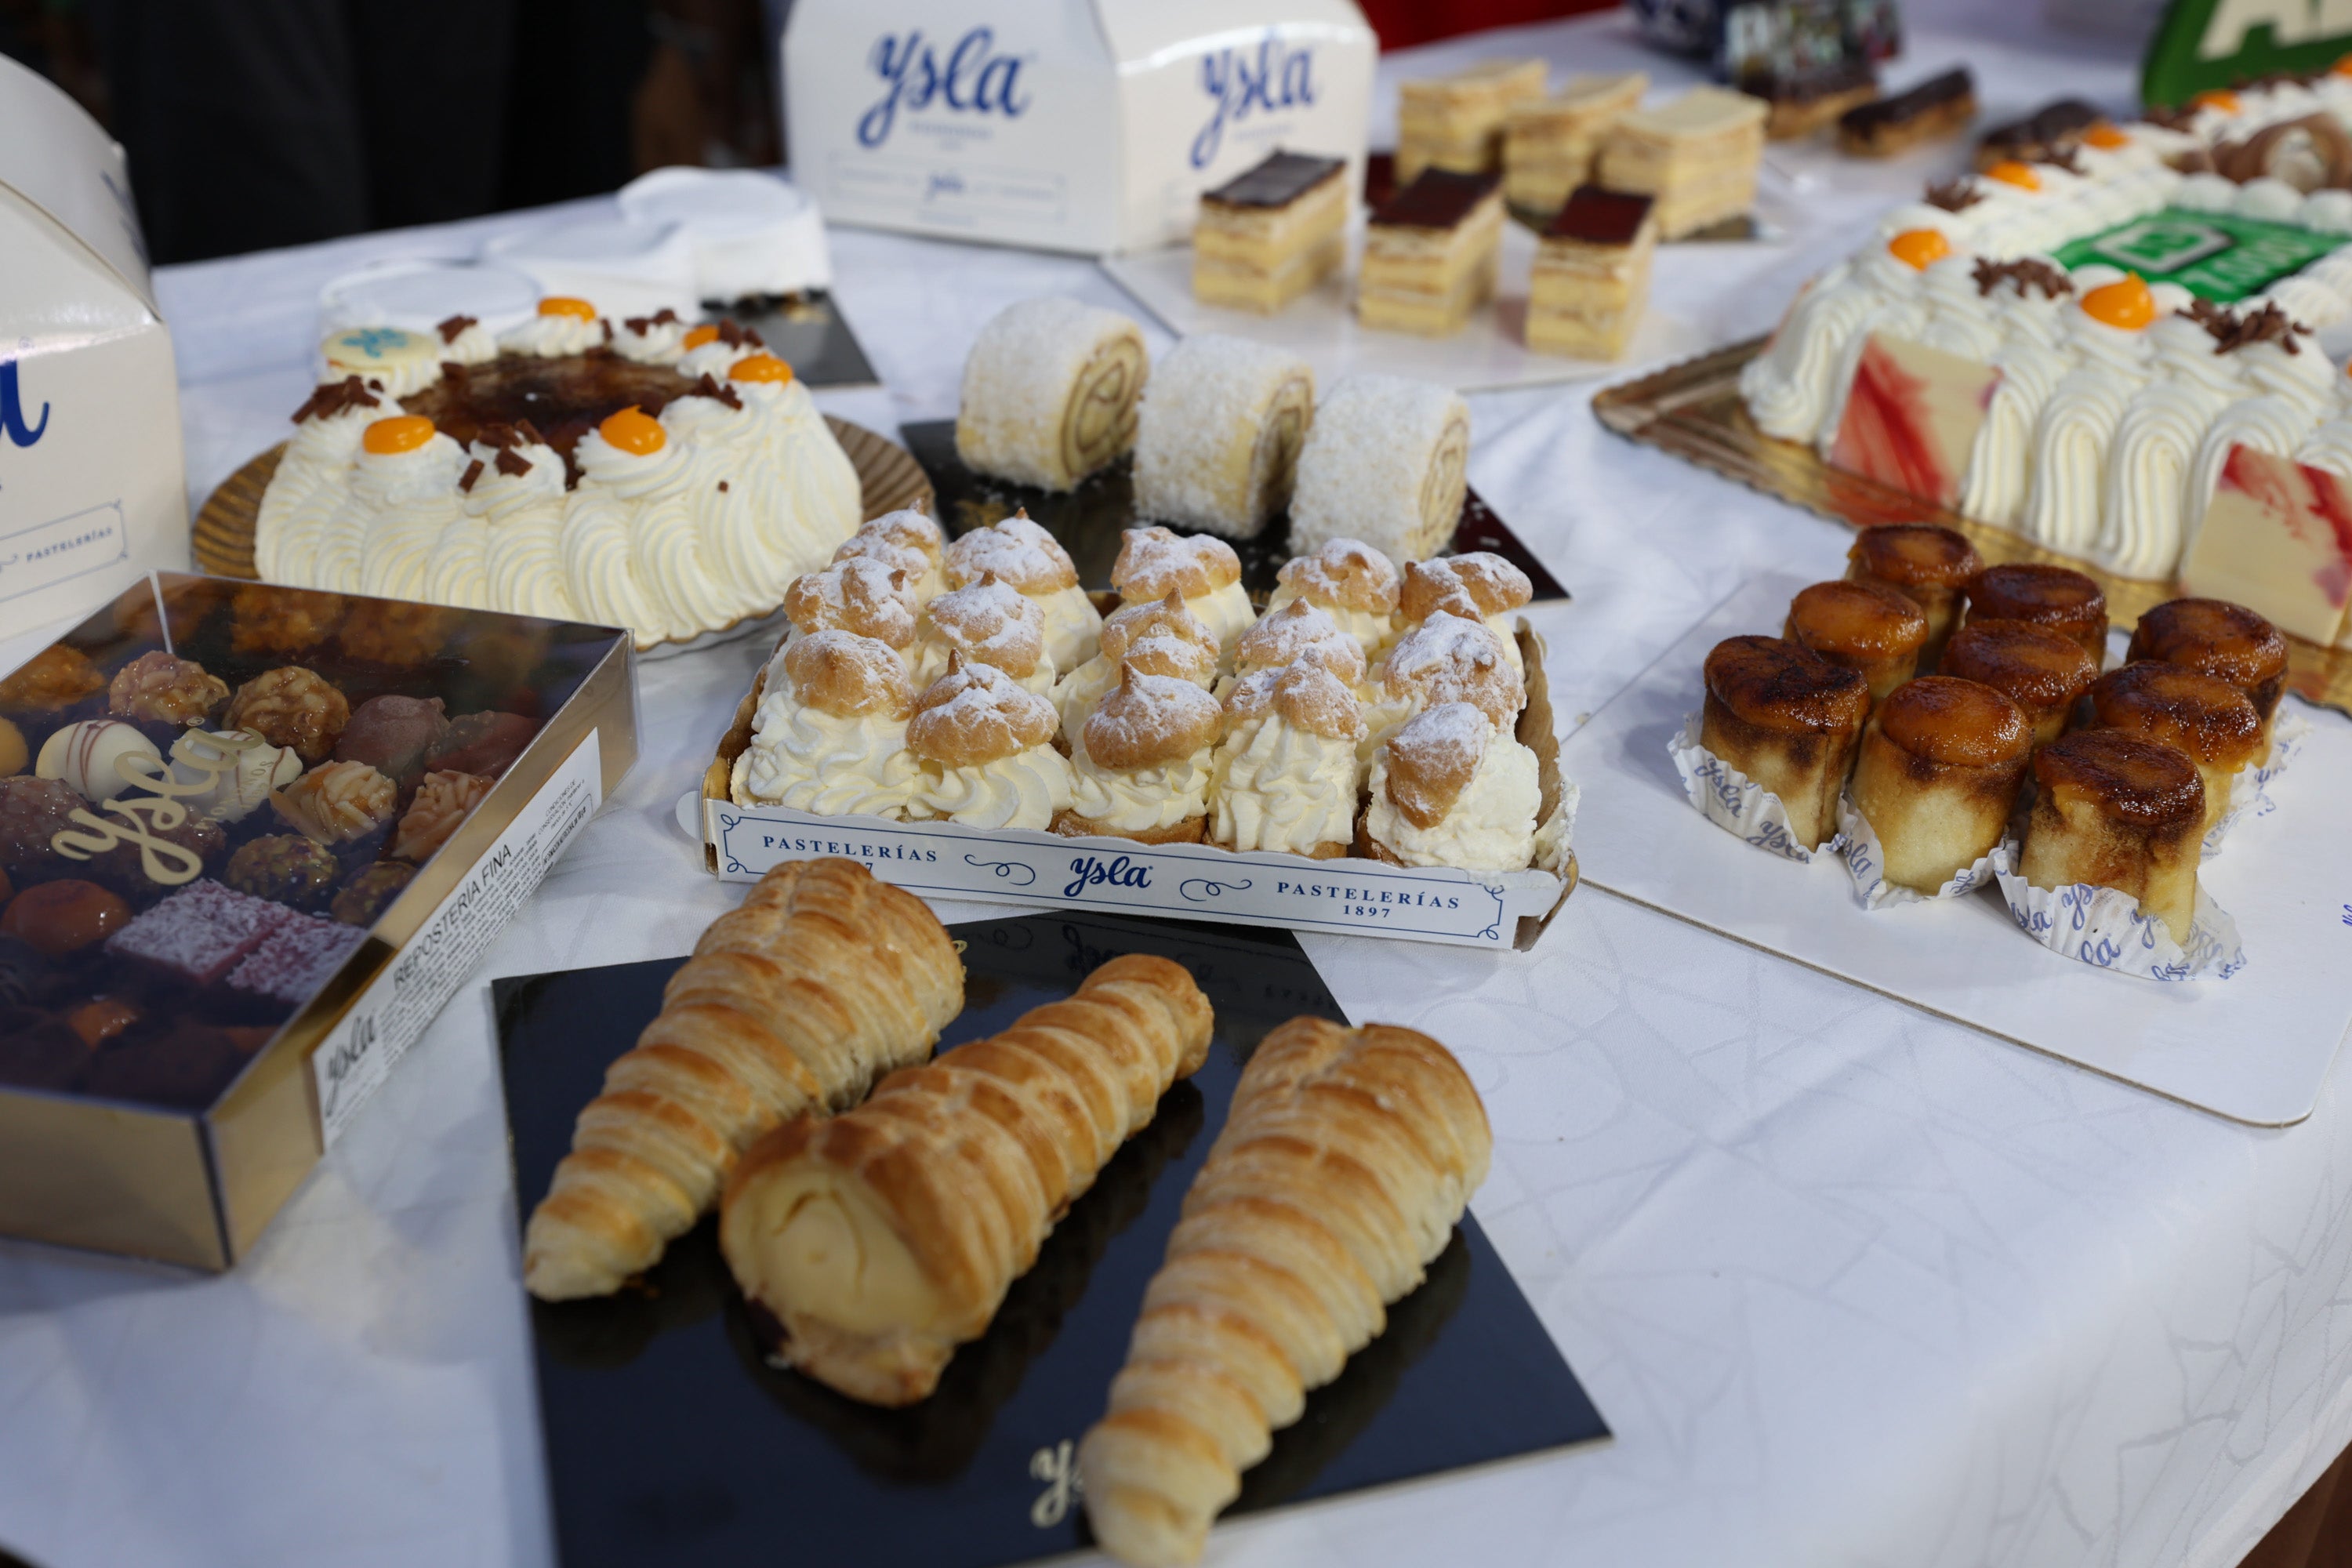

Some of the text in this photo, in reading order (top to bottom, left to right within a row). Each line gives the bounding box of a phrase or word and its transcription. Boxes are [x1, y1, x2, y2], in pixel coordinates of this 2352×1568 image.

[858, 25, 1032, 149] ysla
[1191, 28, 1320, 169] ysla
[27, 526, 113, 563] PASTELERÍAS
[51, 726, 266, 886] ysla
[763, 835, 938, 862] PASTELERÍAS
[1063, 855, 1154, 898] ysla
[1277, 881, 1461, 909] PASTELERÍAS
[393, 880, 481, 992] REPOSTERÍA
[481, 844, 513, 887] FINA
[1342, 905, 1392, 919] 1897
